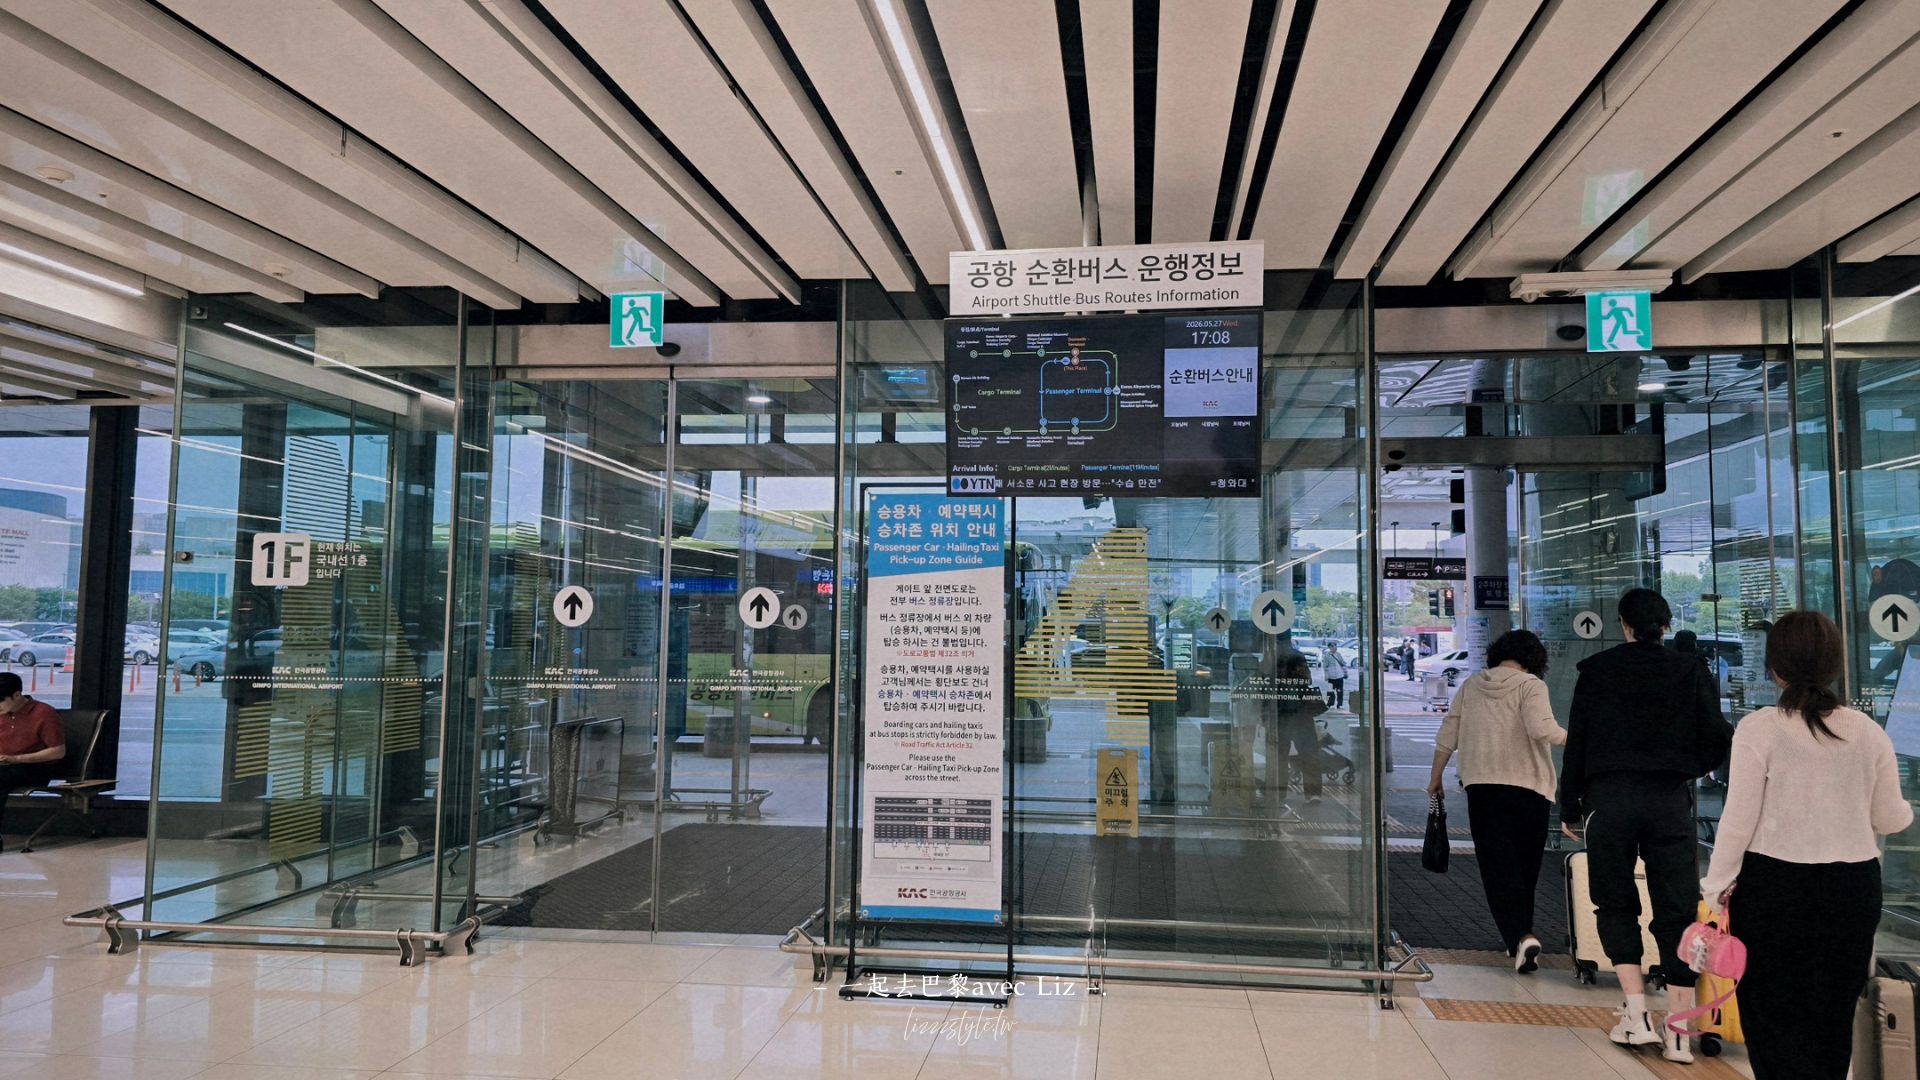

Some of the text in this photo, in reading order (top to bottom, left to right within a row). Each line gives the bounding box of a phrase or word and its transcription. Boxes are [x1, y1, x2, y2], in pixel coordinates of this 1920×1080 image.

[968, 252, 1244, 288] 공항 순환버스 운행정보
[972, 288, 1239, 309] Airport Shuttle Bus Routes Information
[1192, 331, 1230, 344] 17:08
[1169, 368, 1252, 384] 순환버스안내
[971, 478, 995, 489] YTN
[1038, 479, 1056, 488] 사고
[1061, 479, 1078, 488] 현장
[877, 504, 996, 519] 승용차 예약택시
[877, 523, 996, 538] 승차존 위치 안내
[318, 542, 362, 552] 현재 위치는
[874, 543, 999, 553] Passenger Car Hailing Taxi
[261, 541, 304, 578] 1F
[316, 555, 347, 566] 국내선
[890, 555, 983, 565] Pick-up Zone Guide
[316, 569, 341, 578] 입니다
[896, 584, 976, 594] 게이트 앞 전면도로는
[890, 596, 982, 606] 전부 버스 정류장입니다.
[880, 614, 991, 623] 버스 정류장에서 버스 외 차량
[890, 626, 981, 635] (승용차, 예약택시 등)에
[883, 638, 987, 648] 탑승 하시는 건 불법입니다.
[880, 665, 989, 674] 승용차, 예약택시를 사용하실
[881, 677, 989, 687] 고객님께서는 횡단보도 건너
[878, 690, 991, 700] 승용차 예약택시 승차존에서
[883, 702, 985, 712] 탑승하여 주시기 바랍니다.
[884, 721, 913, 730] Boarding
[944, 722, 967, 730] hailing
[916, 731, 939, 740] strictly
[974, 732, 982, 740] by
[866, 764, 899, 772] Passenger
[918, 765, 941, 773] Hailing
[1105, 788, 1128, 797] 미끄럼
[1106, 799, 1128, 807] 주 의
[898, 888, 927, 899] KAC
